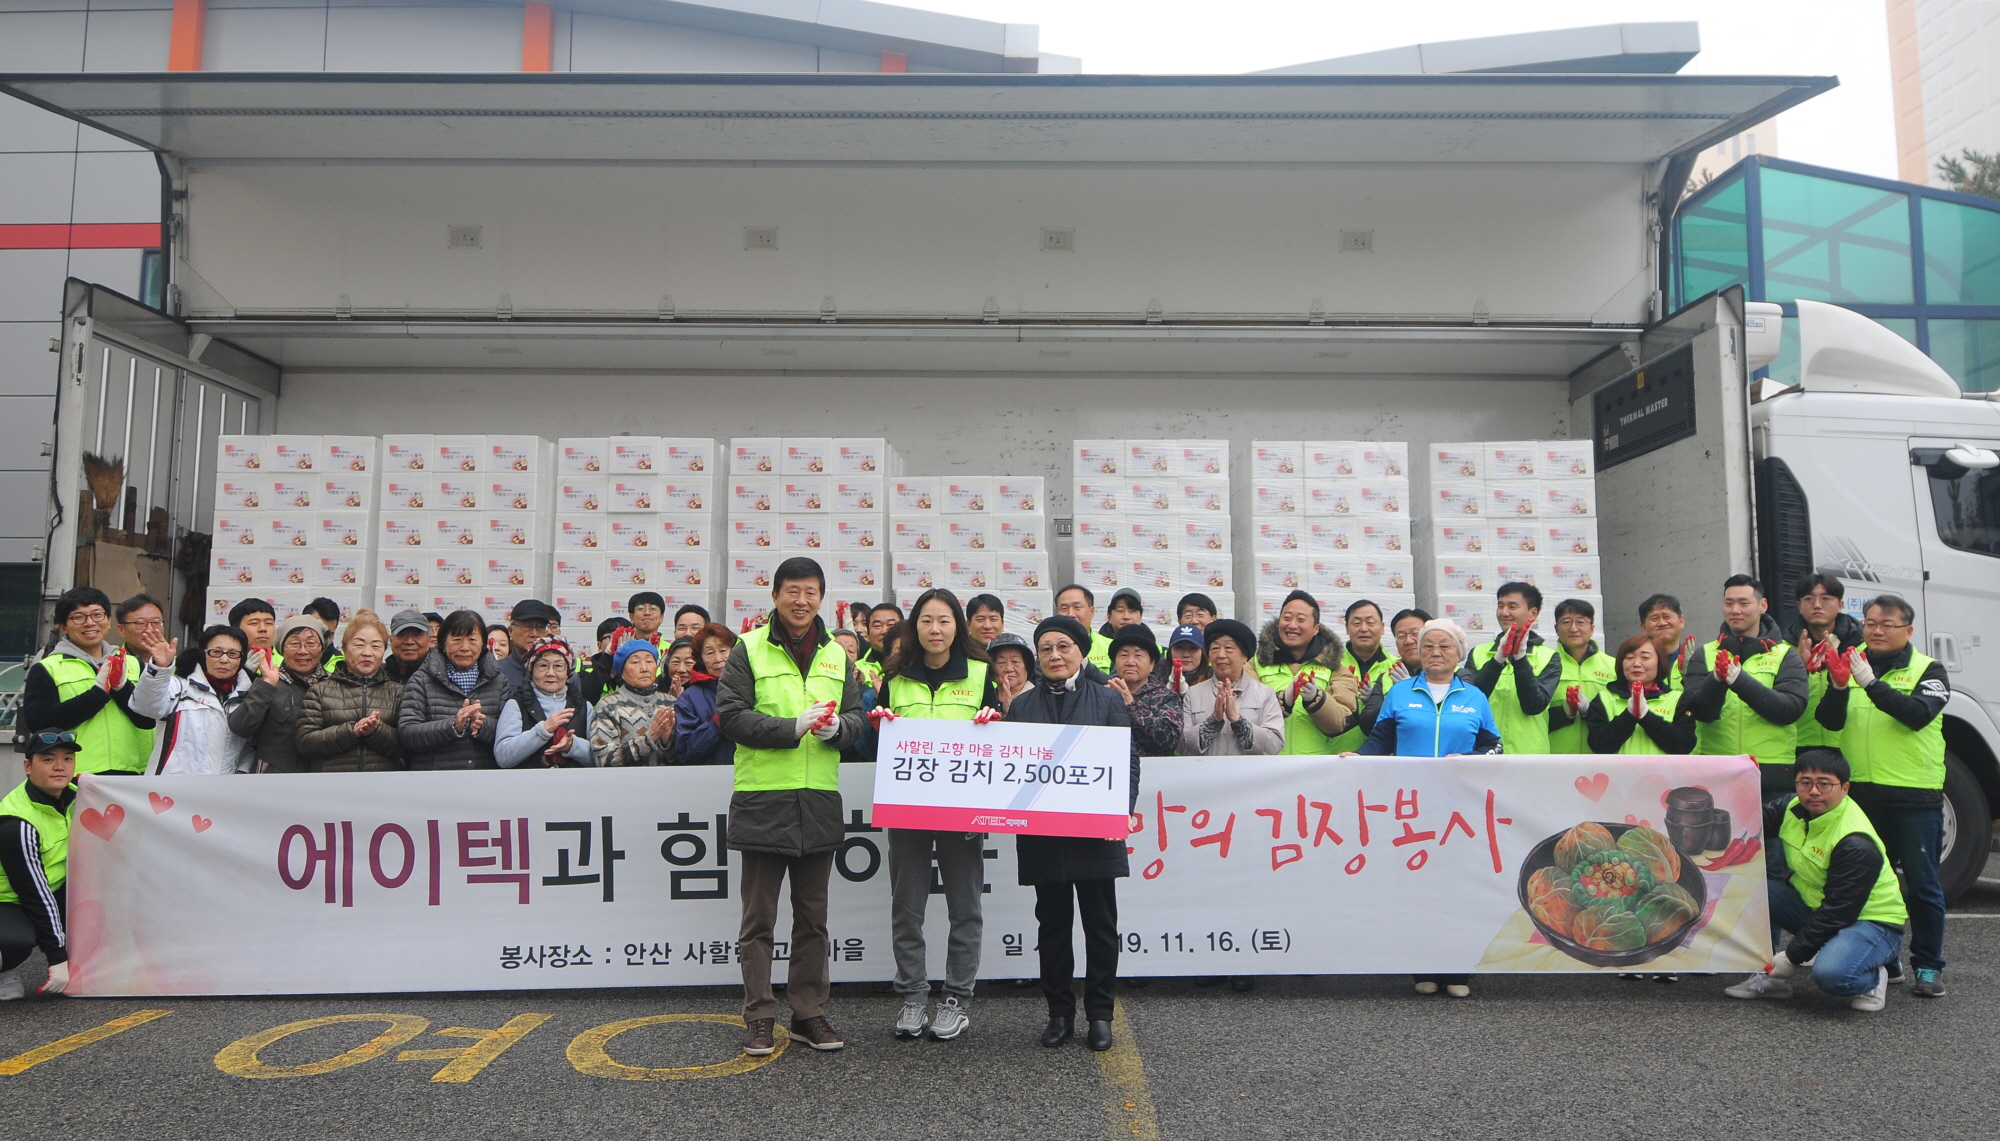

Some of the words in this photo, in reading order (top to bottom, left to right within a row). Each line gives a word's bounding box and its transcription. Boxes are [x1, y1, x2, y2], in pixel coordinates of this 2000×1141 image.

[1620, 409, 1645, 427] THERMAL
[1646, 397, 1669, 416] MASTER
[818, 661, 840, 671] ATEC
[949, 689, 974, 697] ATEC
[895, 739, 934, 755] 사할린
[938, 740, 965, 757] 고향
[969, 742, 994, 758] 마을
[998, 743, 1024, 760] 김치
[1029, 745, 1054, 761] 나눔
[892, 757, 940, 784] 김장
[948, 758, 993, 786] 김치
[1003, 764, 1114, 791] 2,500포기
[971, 815, 1007, 826] ATEC
[277, 816, 626, 908] 에이텍과
[1254, 788, 1514, 876] 김장봉사
[1160, 931, 1195, 954] 11.
[1206, 929, 1241, 954] 16.
[1251, 928, 1293, 954] (토)
[499, 944, 594, 969] 봉사장소
[623, 941, 673, 966] 안산
